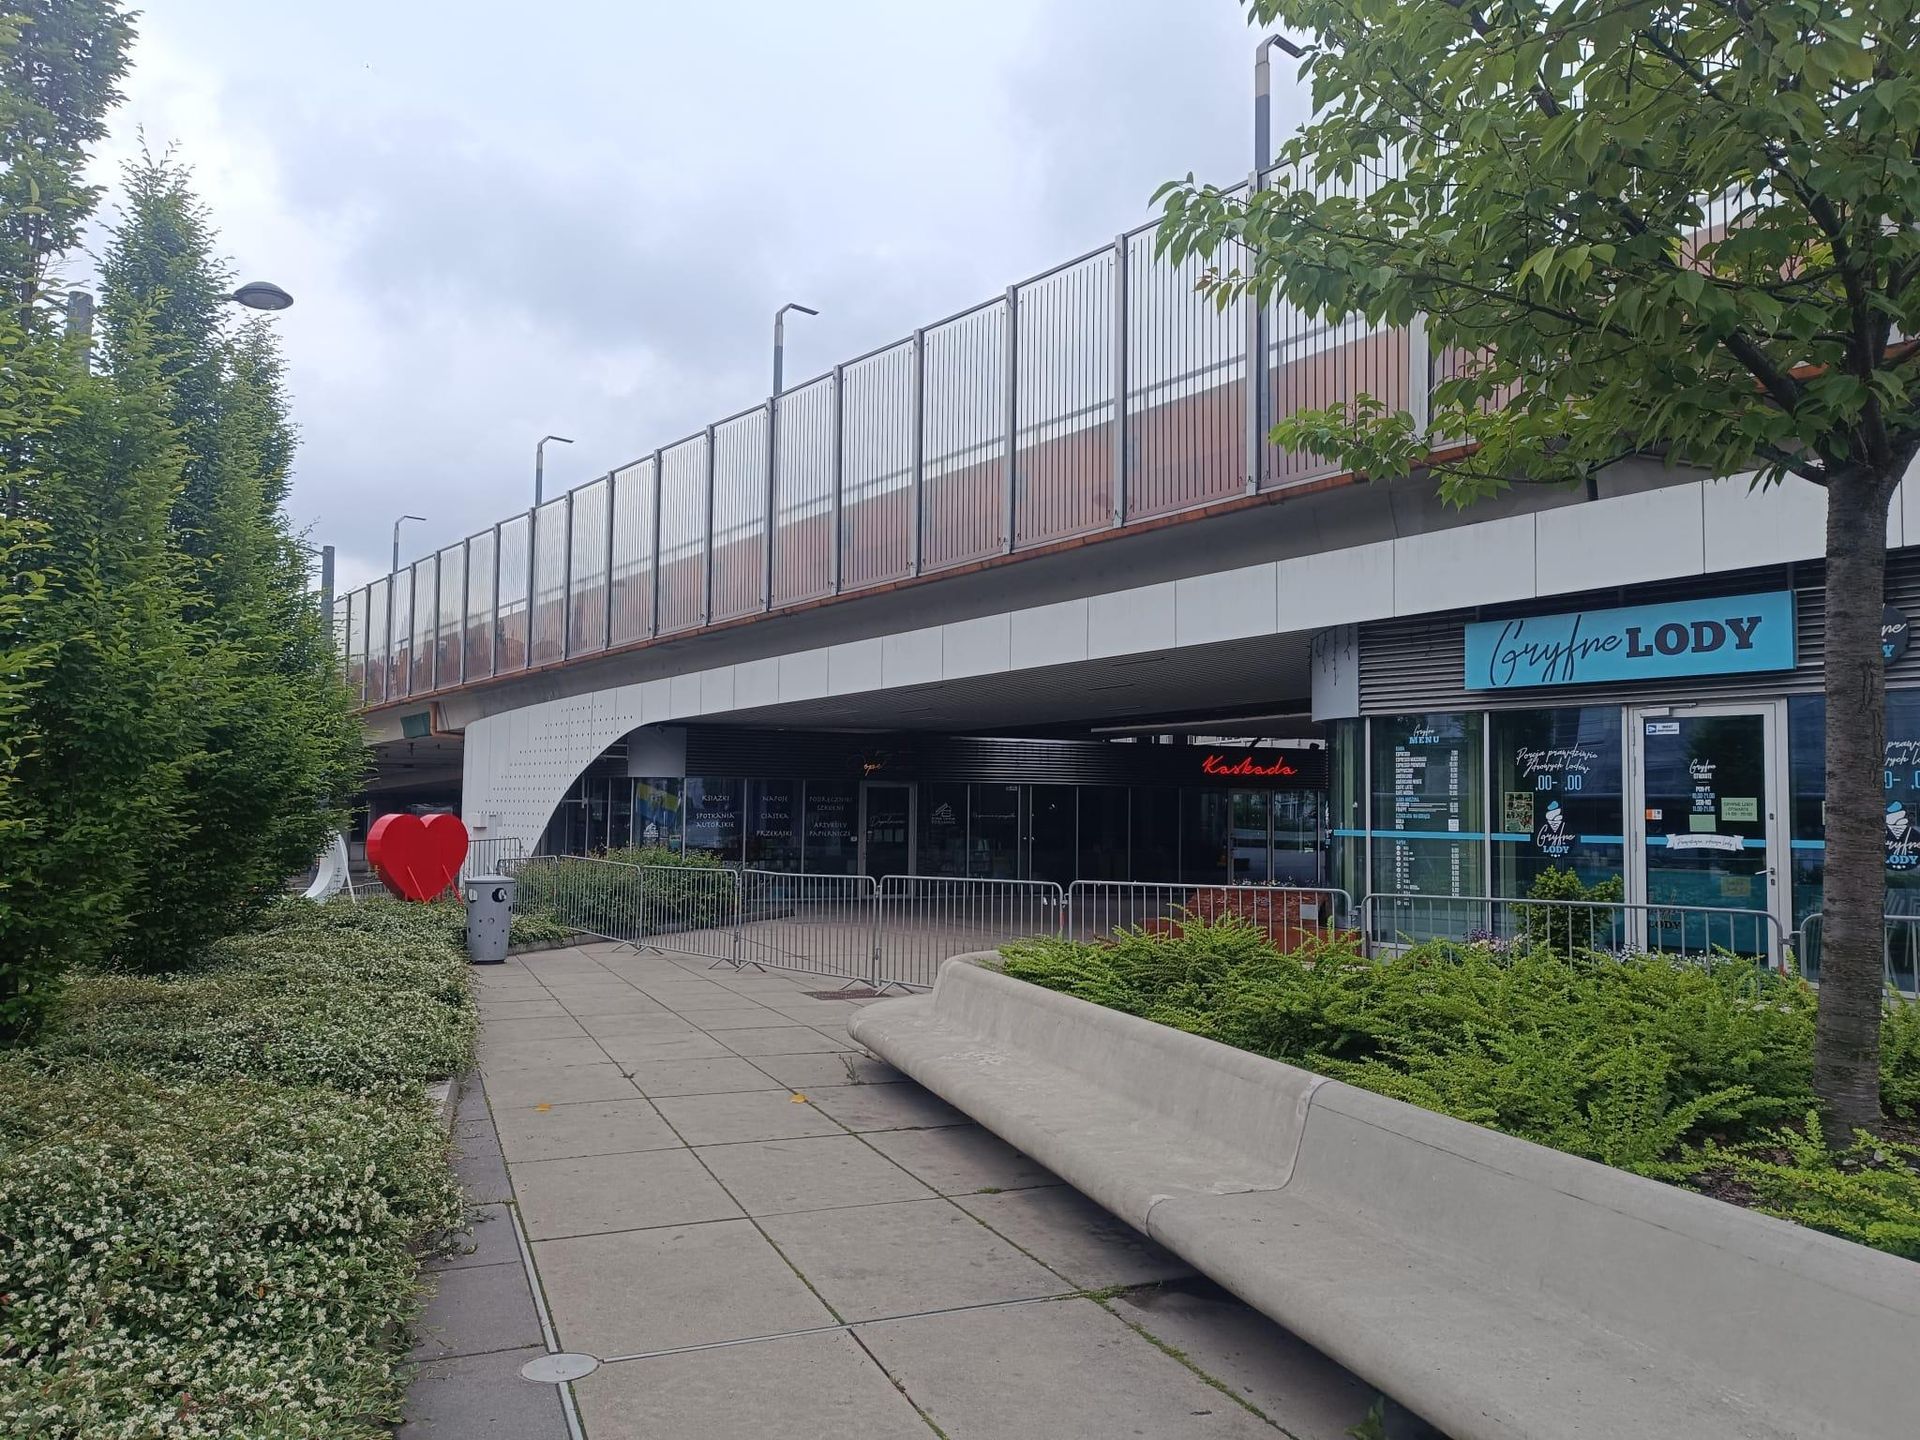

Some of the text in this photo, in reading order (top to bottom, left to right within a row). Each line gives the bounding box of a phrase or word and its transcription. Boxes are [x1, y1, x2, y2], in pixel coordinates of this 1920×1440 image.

[1490, 614, 1762, 686] Gryfne LODY
[1409, 736, 1440, 744] MENU
[1202, 754, 1299, 775] Kaskada
[1537, 822, 1575, 848] Gryfne
[1543, 845, 1570, 854] LODY
